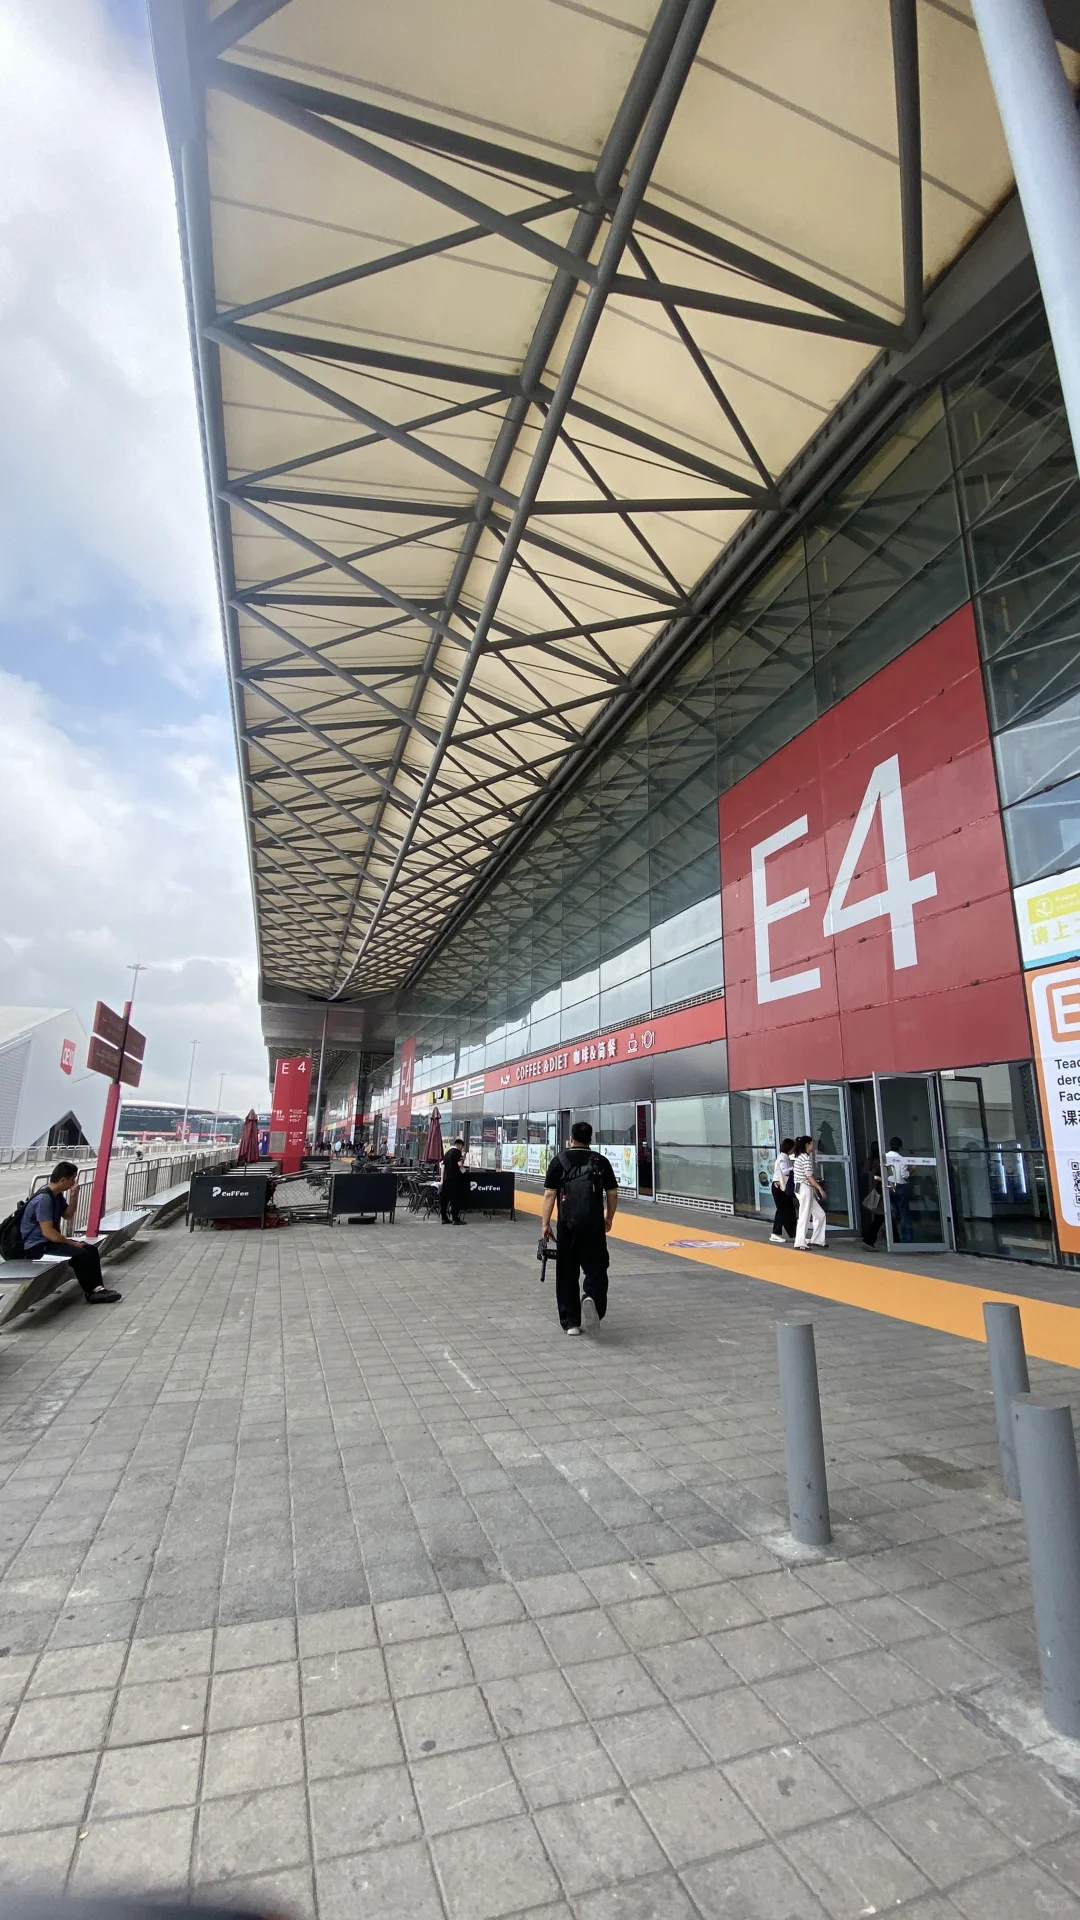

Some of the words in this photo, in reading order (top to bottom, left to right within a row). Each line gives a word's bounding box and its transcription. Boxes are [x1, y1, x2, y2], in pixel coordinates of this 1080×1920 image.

[751, 754, 937, 1005] E4
[1031, 916, 1080, 946] 请上
[515, 1060, 541, 1081] COFFEE
[1061, 1109, 1080, 1126] 课
